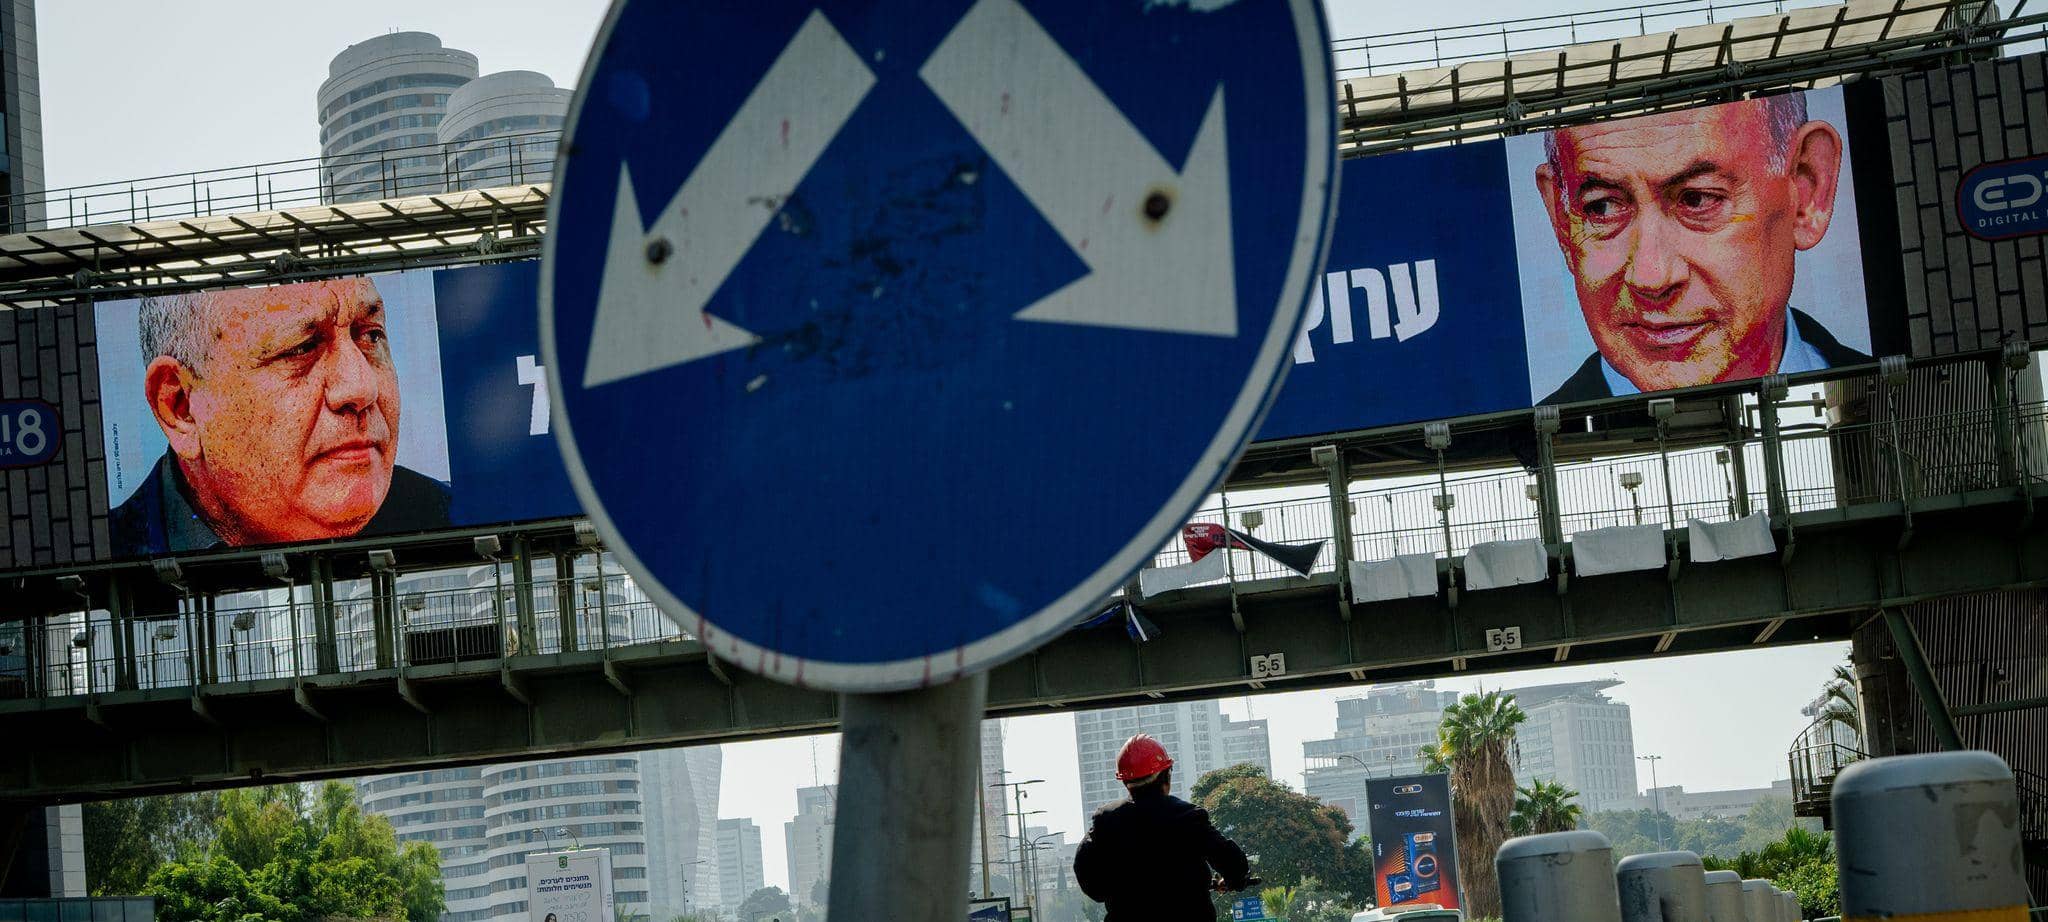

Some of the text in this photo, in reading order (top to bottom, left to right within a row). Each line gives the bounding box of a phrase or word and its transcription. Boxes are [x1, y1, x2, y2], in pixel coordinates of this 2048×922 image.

[1978, 211, 2039, 227] DIGITAL
[1493, 632, 1515, 646] 5.5
[1258, 659, 1280, 672] 5.5
